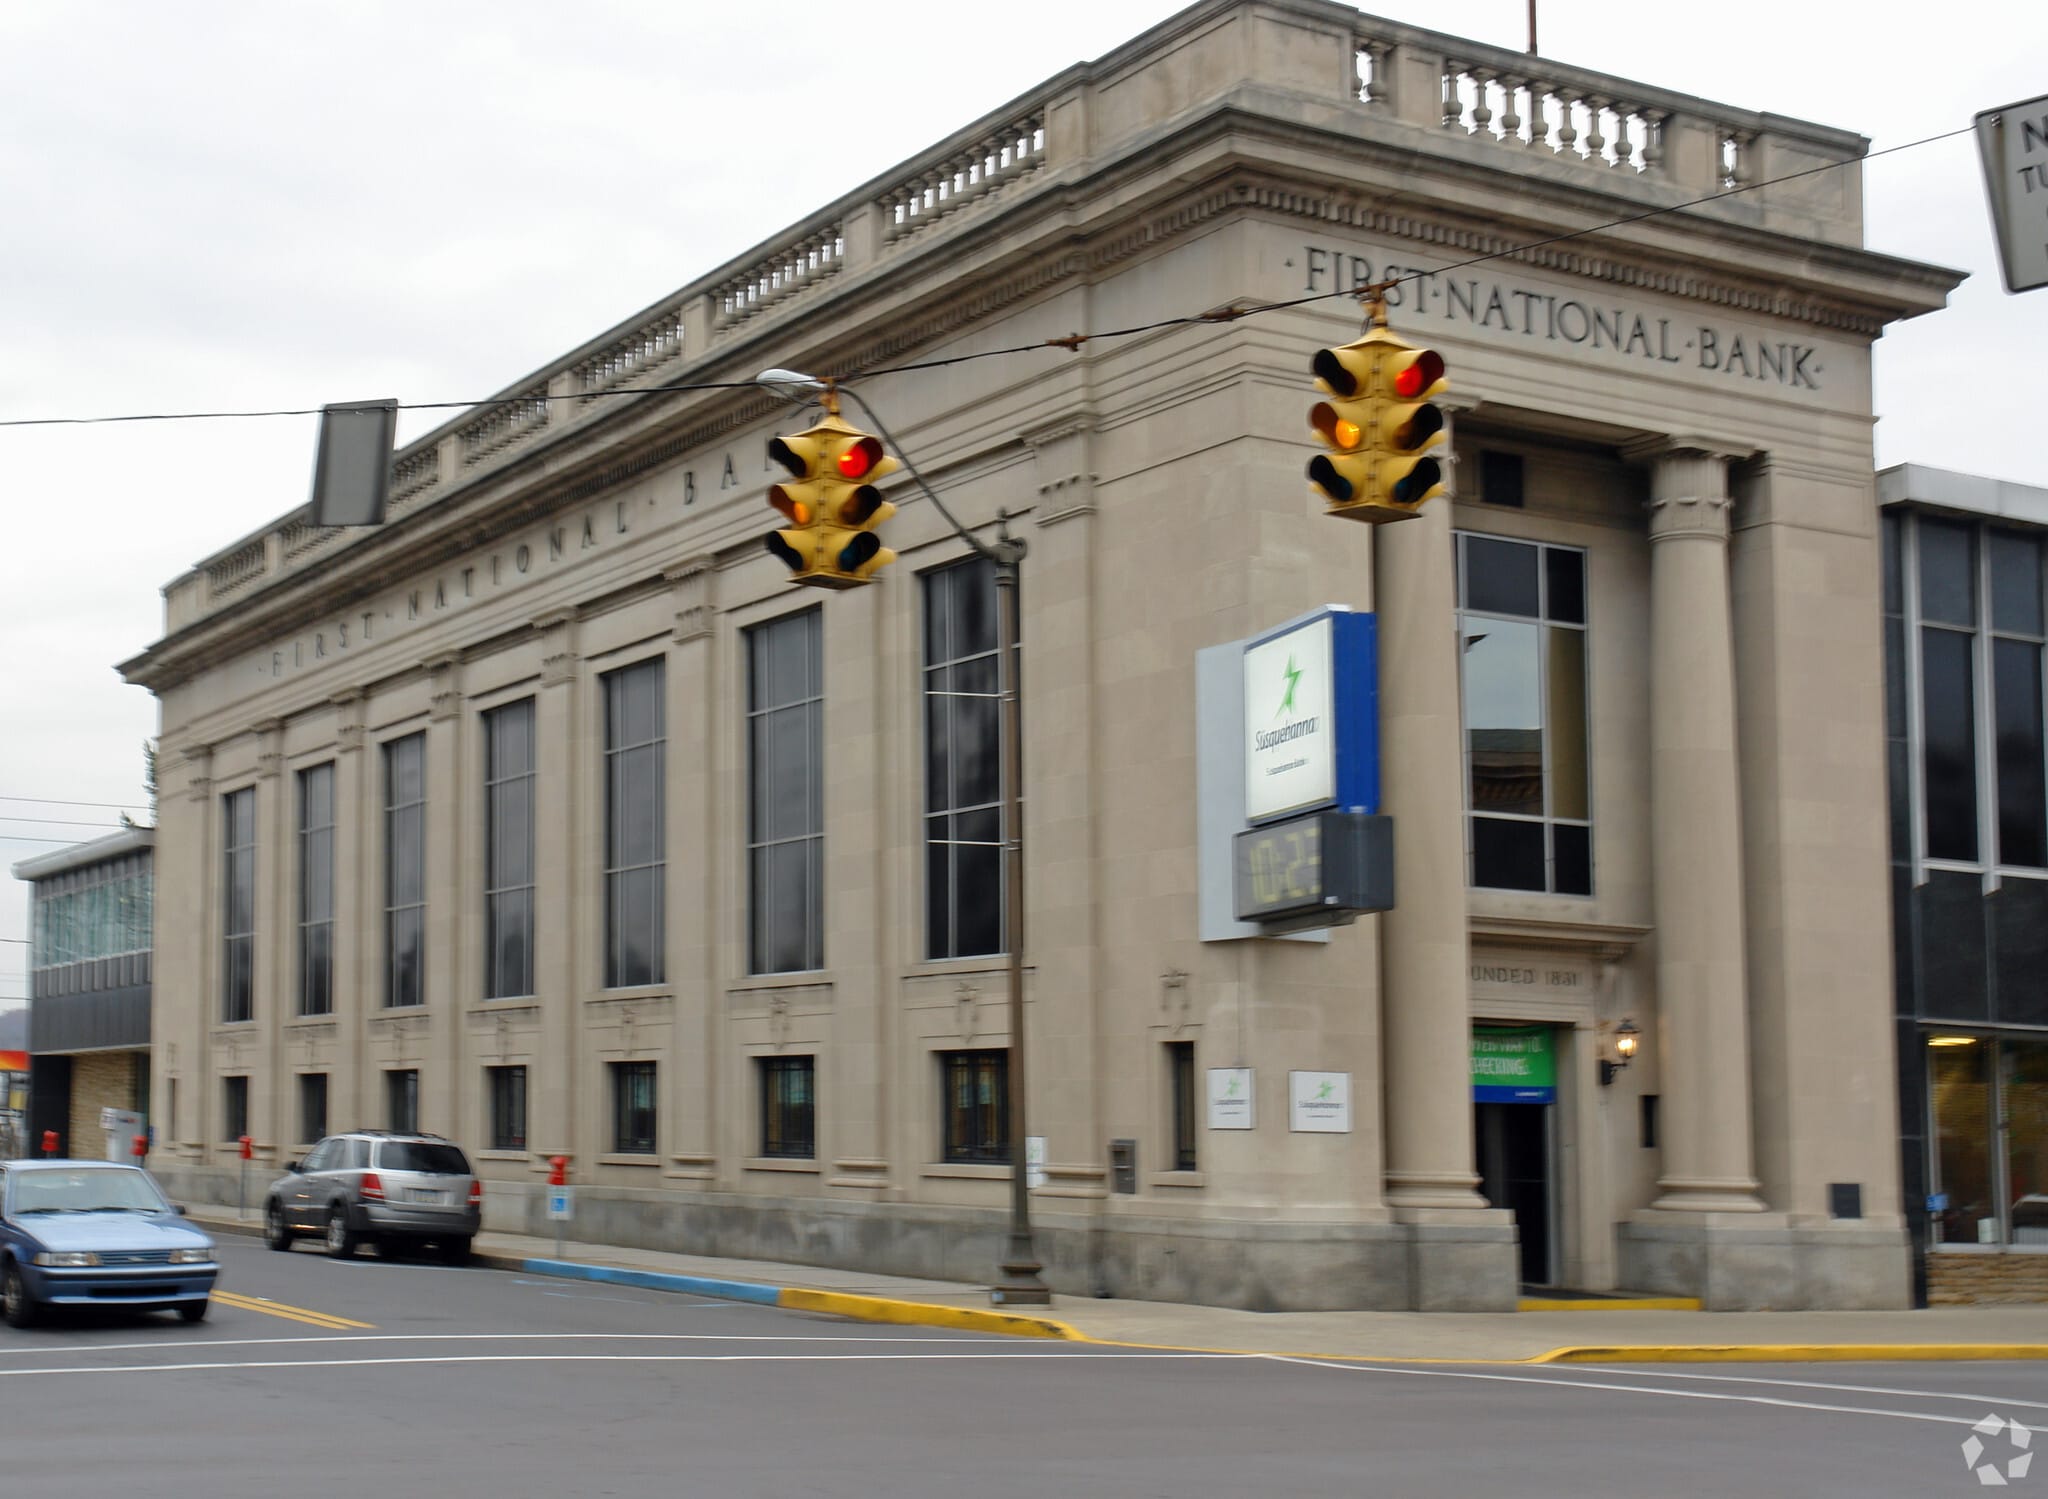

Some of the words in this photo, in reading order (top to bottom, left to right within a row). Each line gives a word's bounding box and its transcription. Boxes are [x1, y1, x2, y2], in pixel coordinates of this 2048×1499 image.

[1304, 246, 1435, 313] FIRST
[1446, 279, 1680, 363] NATIONAL
[1698, 326, 1820, 390] BANK
[271, 611, 375, 677] FIRST
[406, 501, 628, 621] NATIONAL
[1255, 716, 1320, 753] Susquehanna
